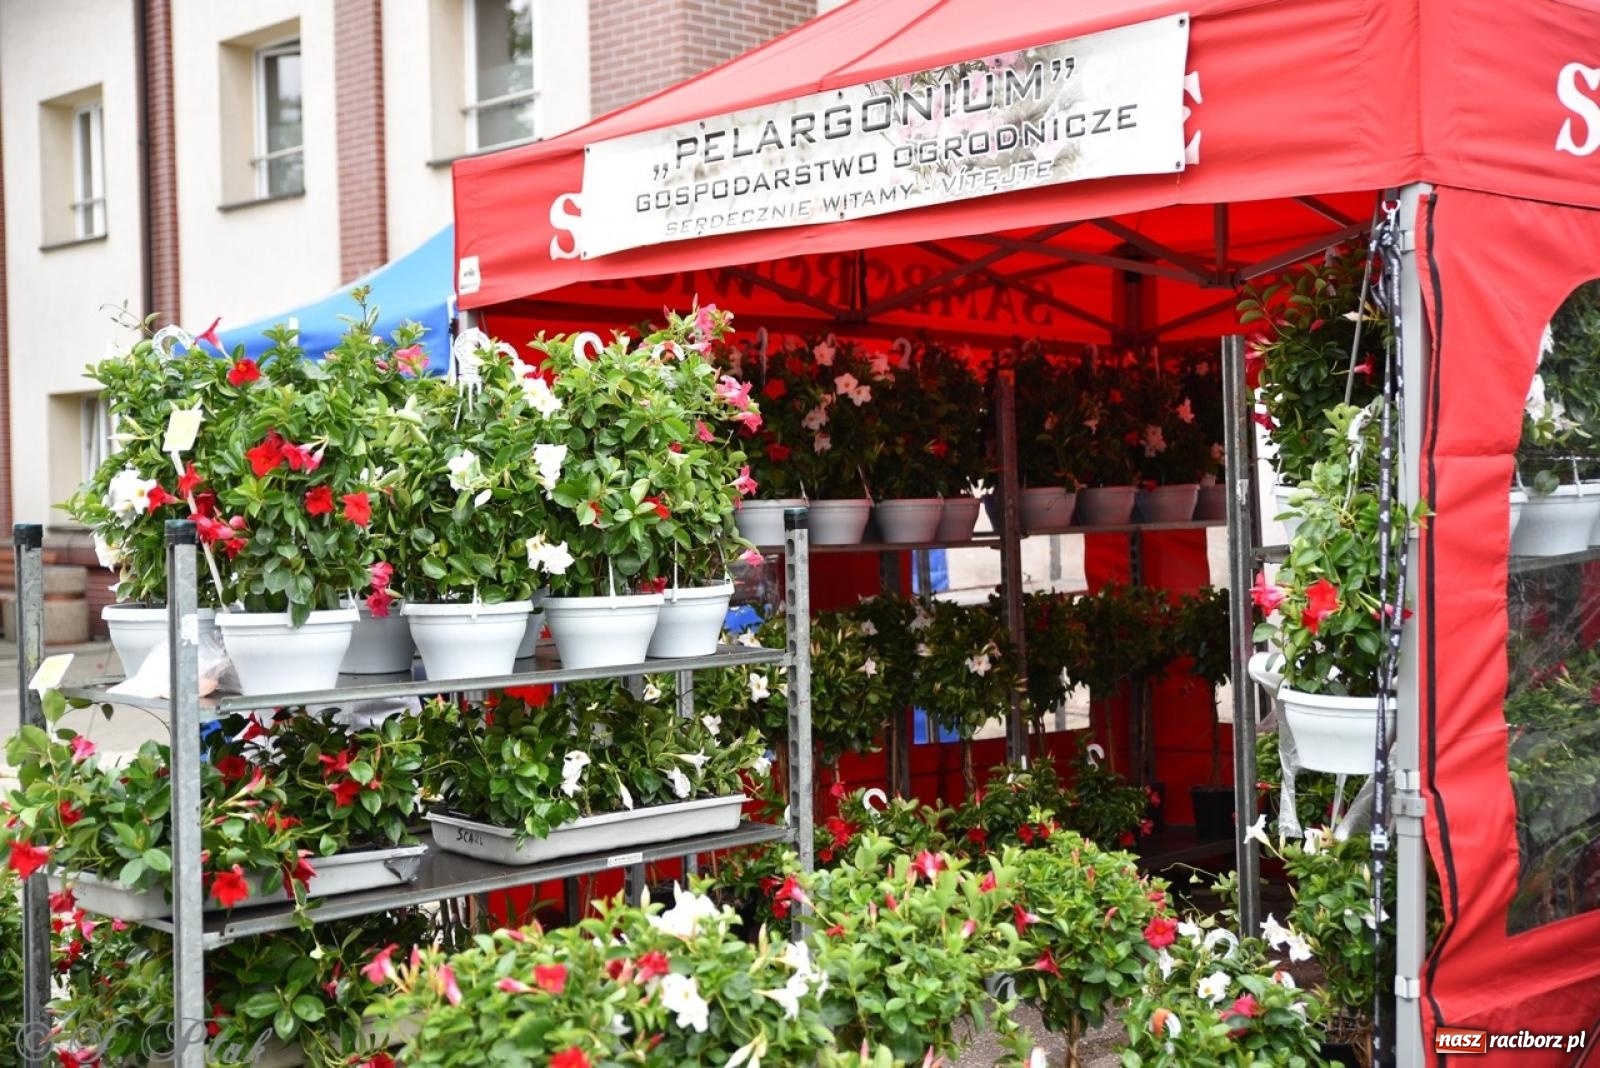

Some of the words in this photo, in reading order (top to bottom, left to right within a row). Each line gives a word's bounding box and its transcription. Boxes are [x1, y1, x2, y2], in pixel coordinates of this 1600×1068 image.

[636, 151, 877, 213] GOSPODARSTWO
[893, 103, 1138, 168] OGRODNICZE
[665, 199, 812, 237] SERDECZNIE
[823, 182, 914, 213] WITAMY
[942, 158, 1052, 193] VÍTEJTE
